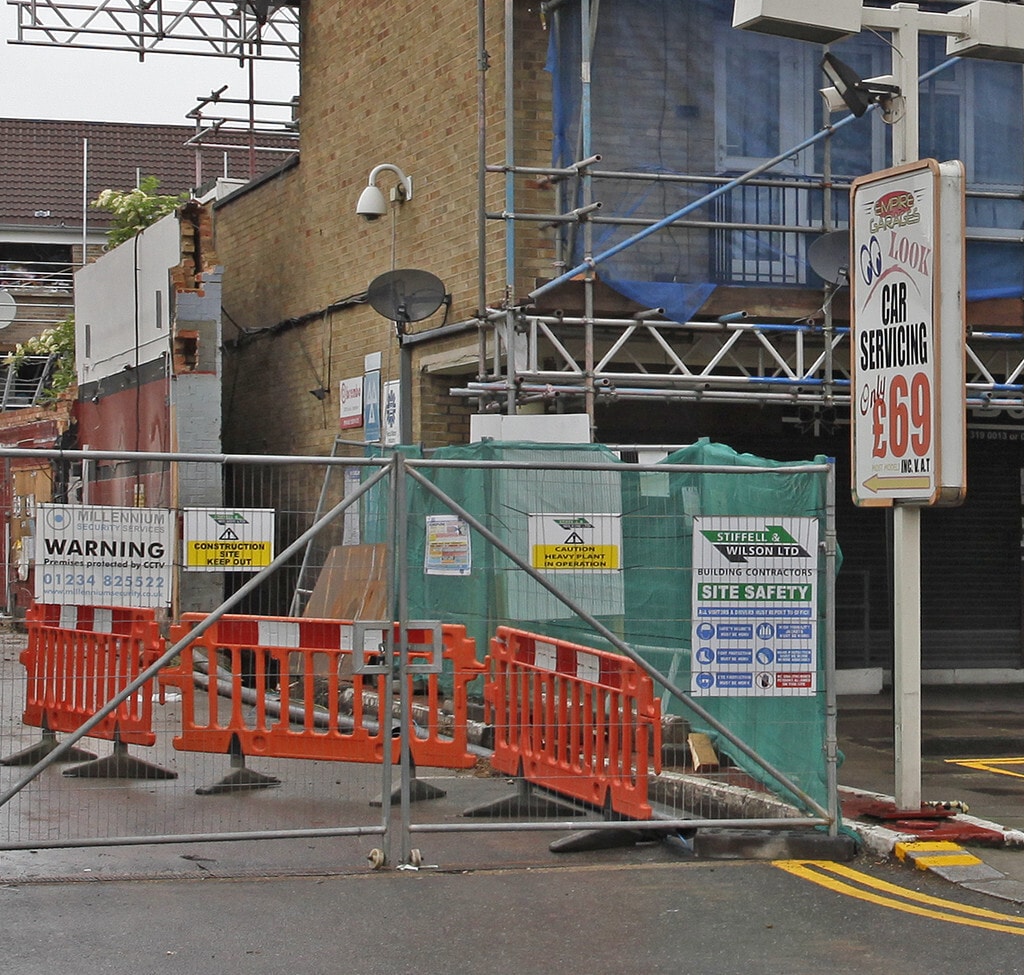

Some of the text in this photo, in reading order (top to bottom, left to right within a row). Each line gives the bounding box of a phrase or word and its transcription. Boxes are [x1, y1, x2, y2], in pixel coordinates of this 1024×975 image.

[874, 193, 914, 216] EMPIRE
[870, 207, 920, 234] GARAGES
[888, 231, 931, 276] LOOK
[882, 282, 907, 325] CAR
[860, 322, 928, 371] SERVICING
[860, 375, 886, 415] Only
[872, 372, 931, 458] £69
[78, 511, 165, 524] MILLENNIUM
[77, 523, 165, 534] SECURITY SERVICES
[717, 532, 780, 542] STIFFELL &
[44, 538, 165, 558] WARNING
[726, 546, 799, 556] WILSON LTD
[44, 558, 165, 570] Premises protected by CCTV
[698, 568, 813, 576] BUILDING CONTRACTORS
[43, 573, 164, 588] 01234 825522
[43, 588, 163, 599] www.millenniumsecurity.co.uk
[702, 585, 808, 599] SITE SAFETY
